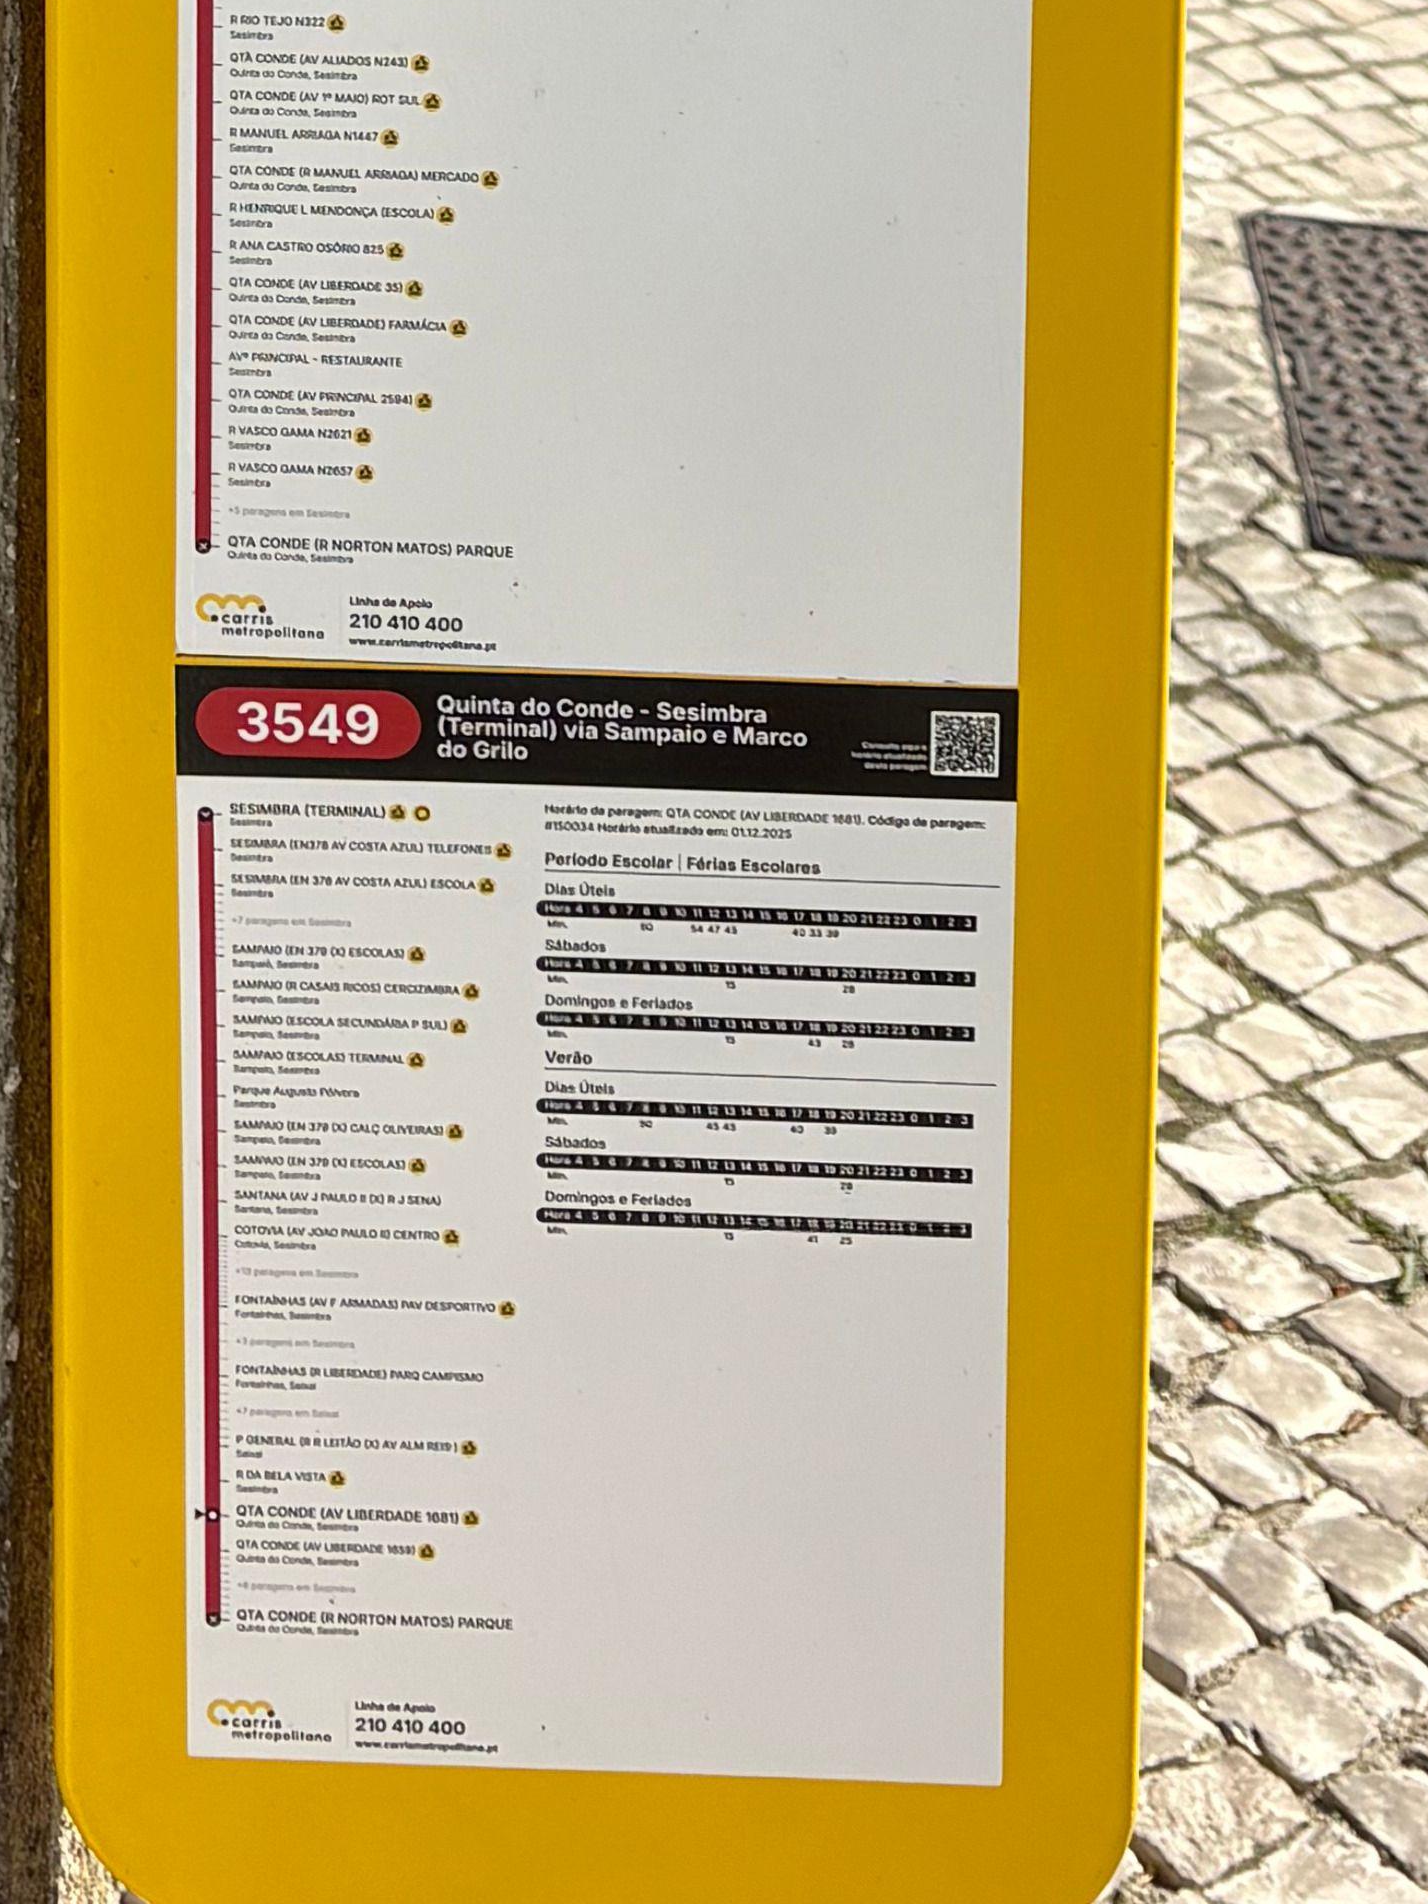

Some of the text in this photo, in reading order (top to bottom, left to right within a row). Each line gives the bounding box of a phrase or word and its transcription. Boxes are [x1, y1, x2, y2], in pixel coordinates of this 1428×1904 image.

[228, 535, 513, 559] QTA CONDE (R NORTON MATOS) PARQUE
[350, 613, 463, 632] 210 410 400
[437, 694, 514, 716] Quinta
[521, 697, 553, 721] do
[557, 698, 633, 722] Conde
[657, 702, 767, 723] Sesimbra
[238, 701, 378, 744] 3549
[438, 716, 807, 747] (Terminal) via Sampaio e Marco
[437, 740, 528, 760] do Grilo
[230, 802, 386, 819] SESIMBRA (TERMINAL)
[545, 1050, 592, 1065] Verão
[232, 1715, 282, 1731] carris
[356, 1717, 465, 1736] 210 410 400
[232, 1730, 331, 1742] metropolitana
